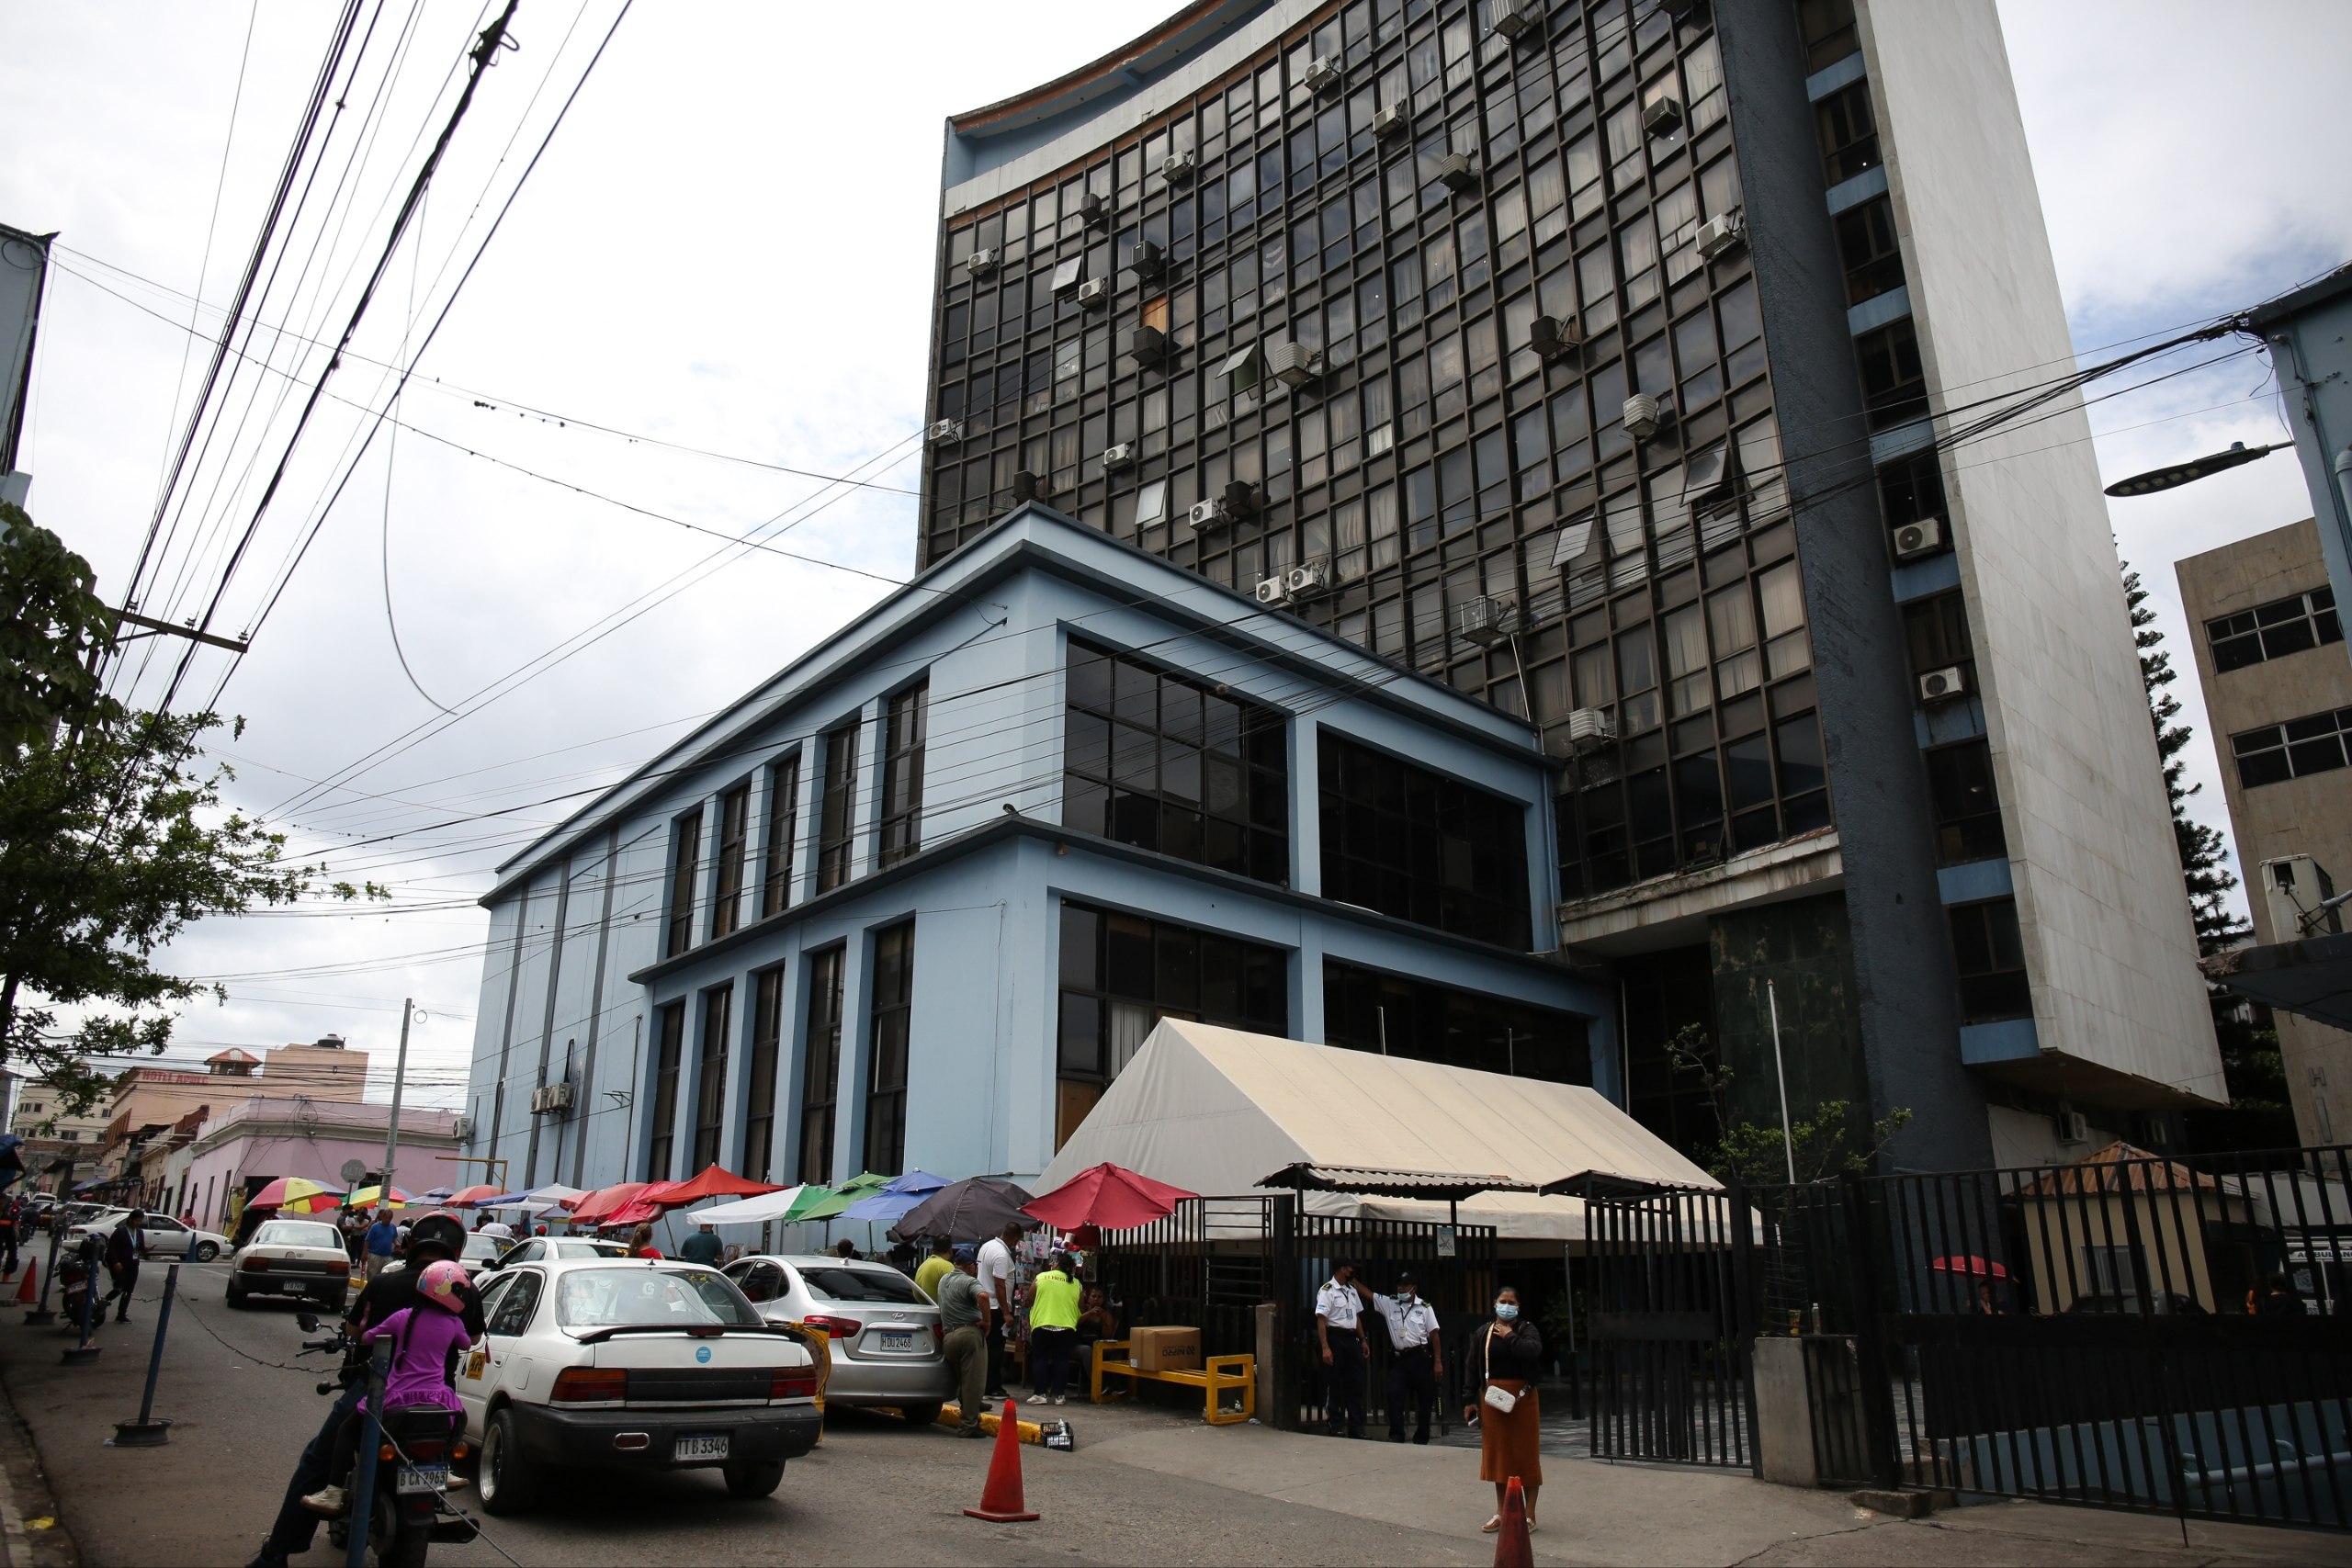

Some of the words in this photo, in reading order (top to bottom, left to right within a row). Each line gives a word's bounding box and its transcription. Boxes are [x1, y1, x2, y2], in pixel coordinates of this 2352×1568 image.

[141, 1070, 172, 1082] HOTEL
[344, 1167, 365, 1177] ALTO
[896, 1337, 911, 1348] 2468
[700, 1437, 727, 1455] 3346
